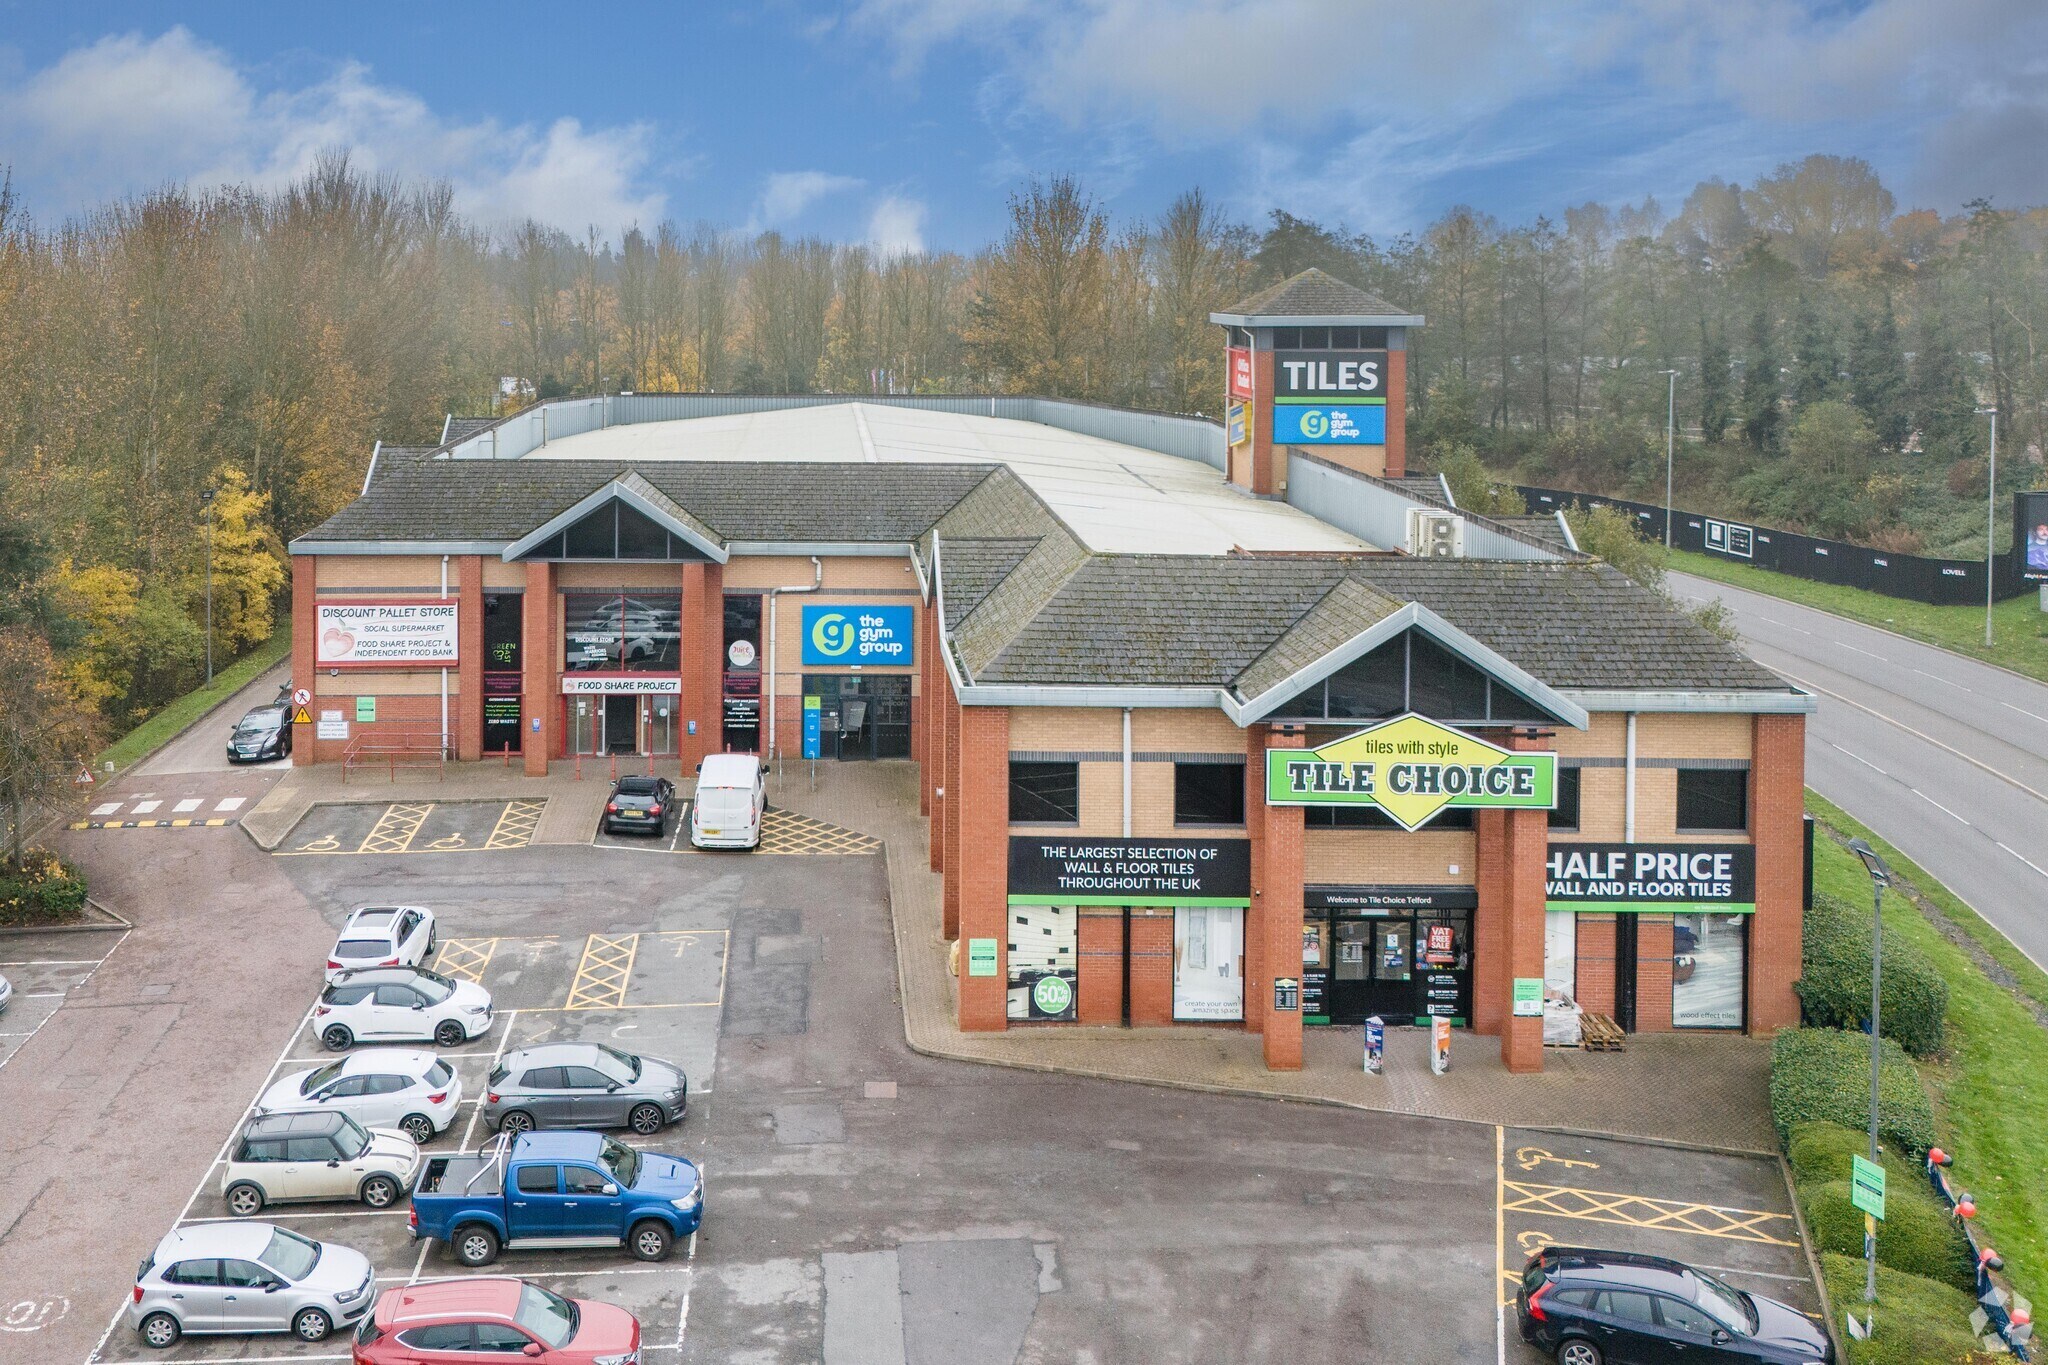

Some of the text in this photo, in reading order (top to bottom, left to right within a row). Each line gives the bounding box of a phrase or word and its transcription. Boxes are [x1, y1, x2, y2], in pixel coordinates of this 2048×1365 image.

[1283, 362, 1378, 390] TILES
[1331, 411, 1347, 419] the
[1331, 419, 1353, 429] gym
[1331, 428, 1359, 438] group
[1942, 568, 1965, 576] LOVELL
[322, 607, 454, 618] DISCOUNT PALLET STORE
[860, 615, 884, 626] the
[392, 624, 445, 632] SUPERMARKET
[860, 628, 893, 643] gym
[357, 640, 377, 648] FOOD
[380, 640, 406, 648] SHARE
[860, 641, 902, 656] group
[355, 649, 407, 657] INDEPENDENT
[432, 648, 453, 656] BANK
[578, 682, 602, 690] FOOD
[637, 682, 677, 690] PROJECT
[1366, 740, 1459, 758] tiles with style
[1287, 761, 1536, 797] TILE CHOICE
[1042, 847, 1217, 859] THE LARGEST SELECTION OF
[1064, 862, 1194, 874] WALL & FLOOR TILES
[1546, 852, 1732, 880] HALF PRICE
[1058, 877, 1201, 890] THROUGHOUT THE UK
[1546, 882, 1732, 897] WALL AND FLOOR TILES
[1058, 995, 1067, 1003] off
